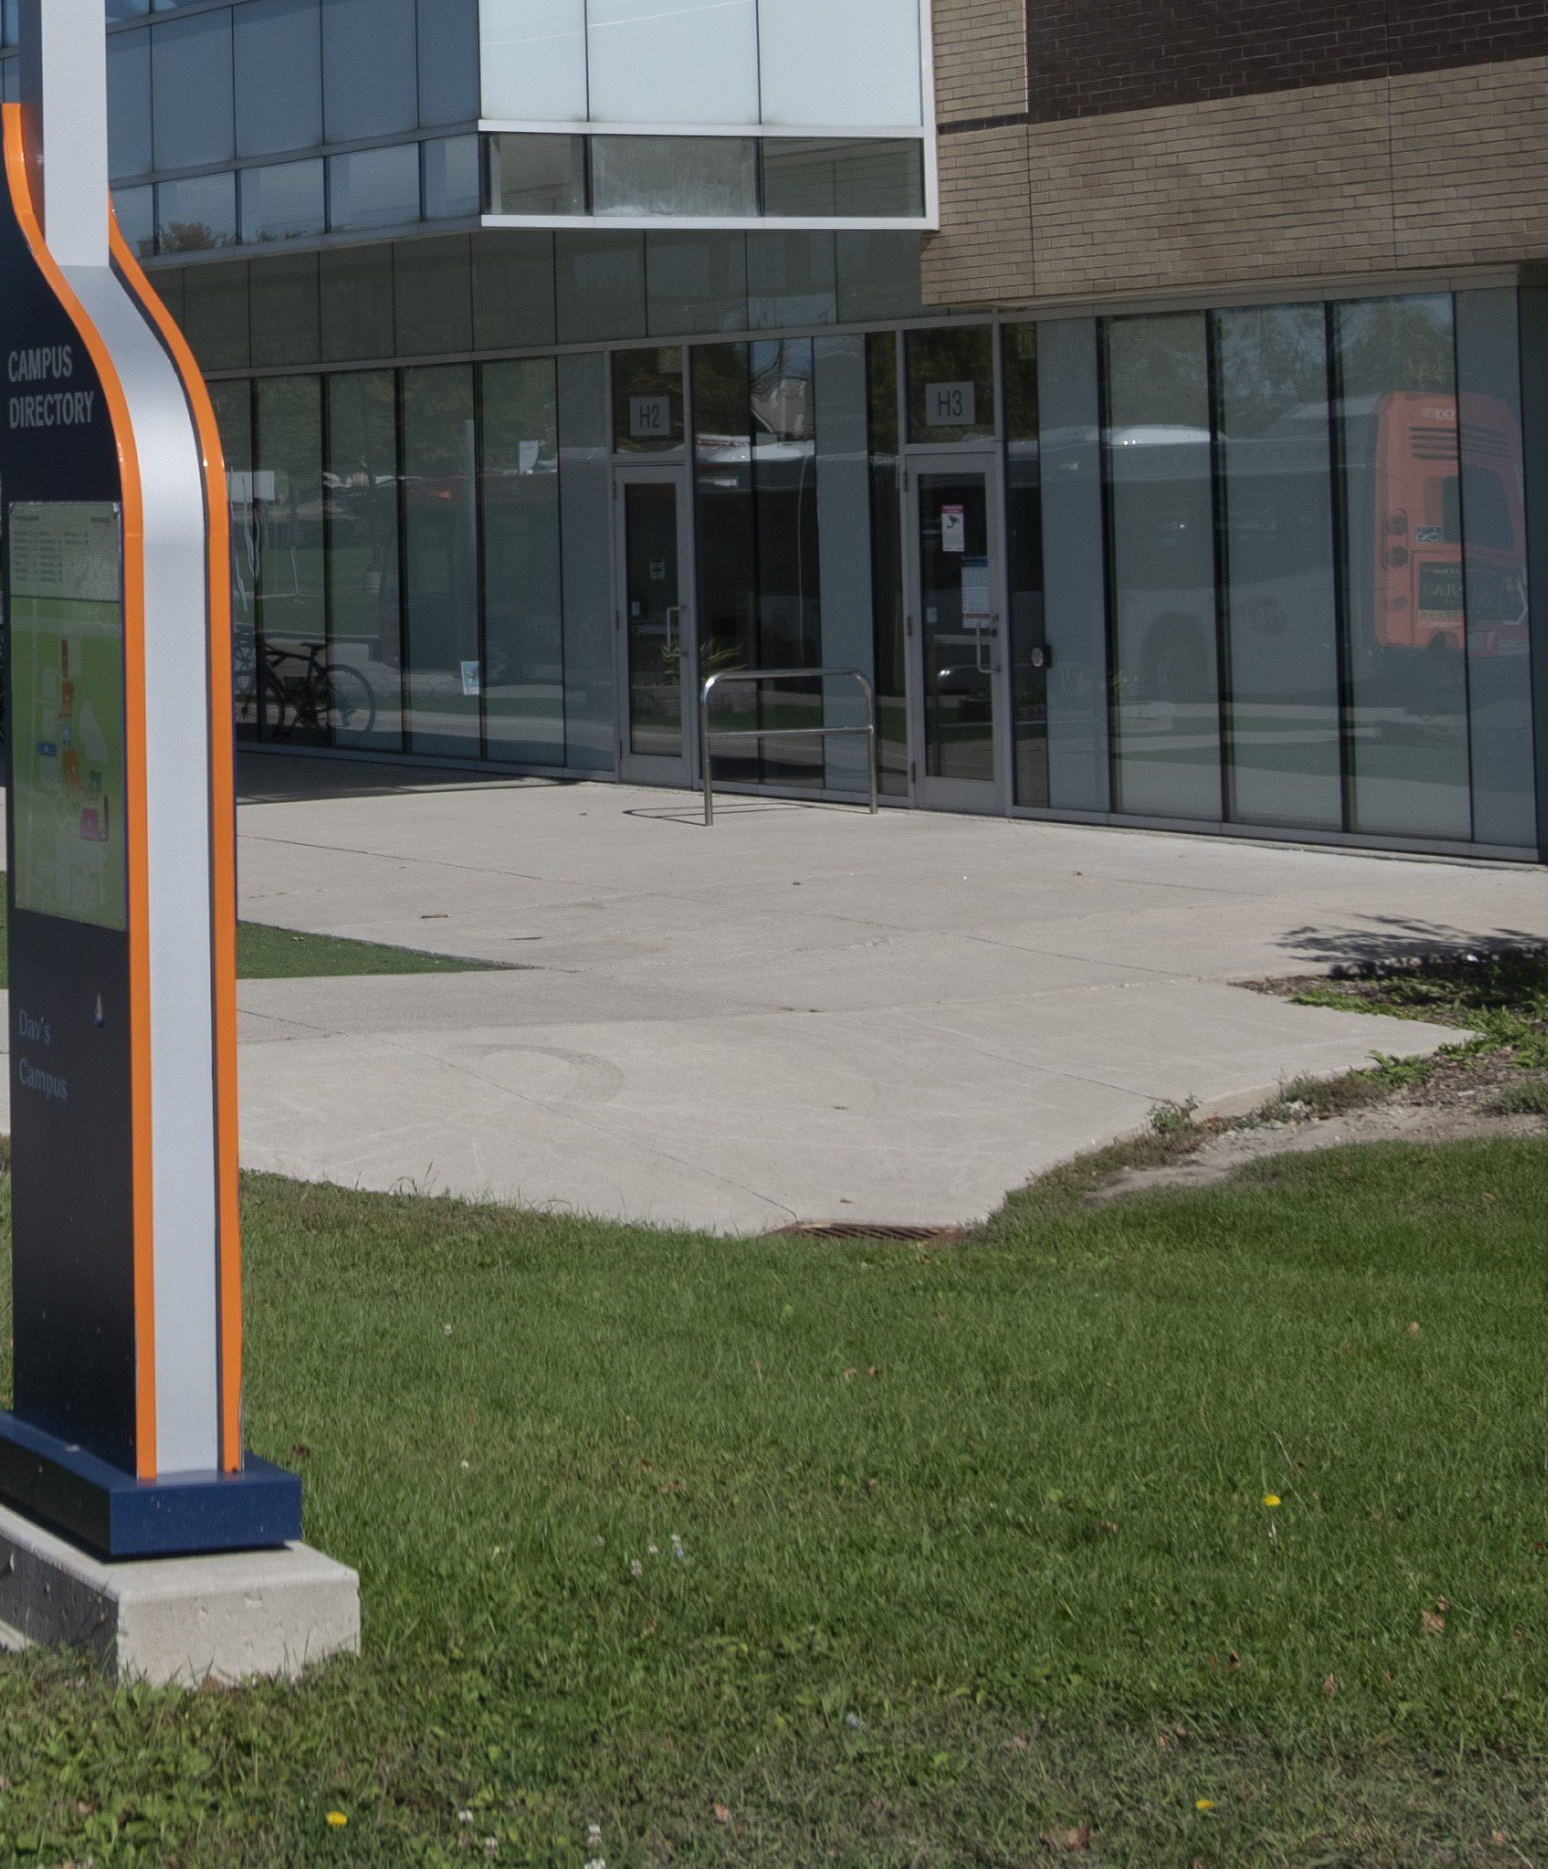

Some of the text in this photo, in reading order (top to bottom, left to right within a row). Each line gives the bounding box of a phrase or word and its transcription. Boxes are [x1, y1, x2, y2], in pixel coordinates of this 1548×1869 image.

[8, 344, 73, 383] CAMPUS
[9, 390, 94, 429] DIRECTORY
[639, 403, 661, 429] H2
[937, 389, 963, 418] H3
[19, 1057, 68, 1102] Campus
